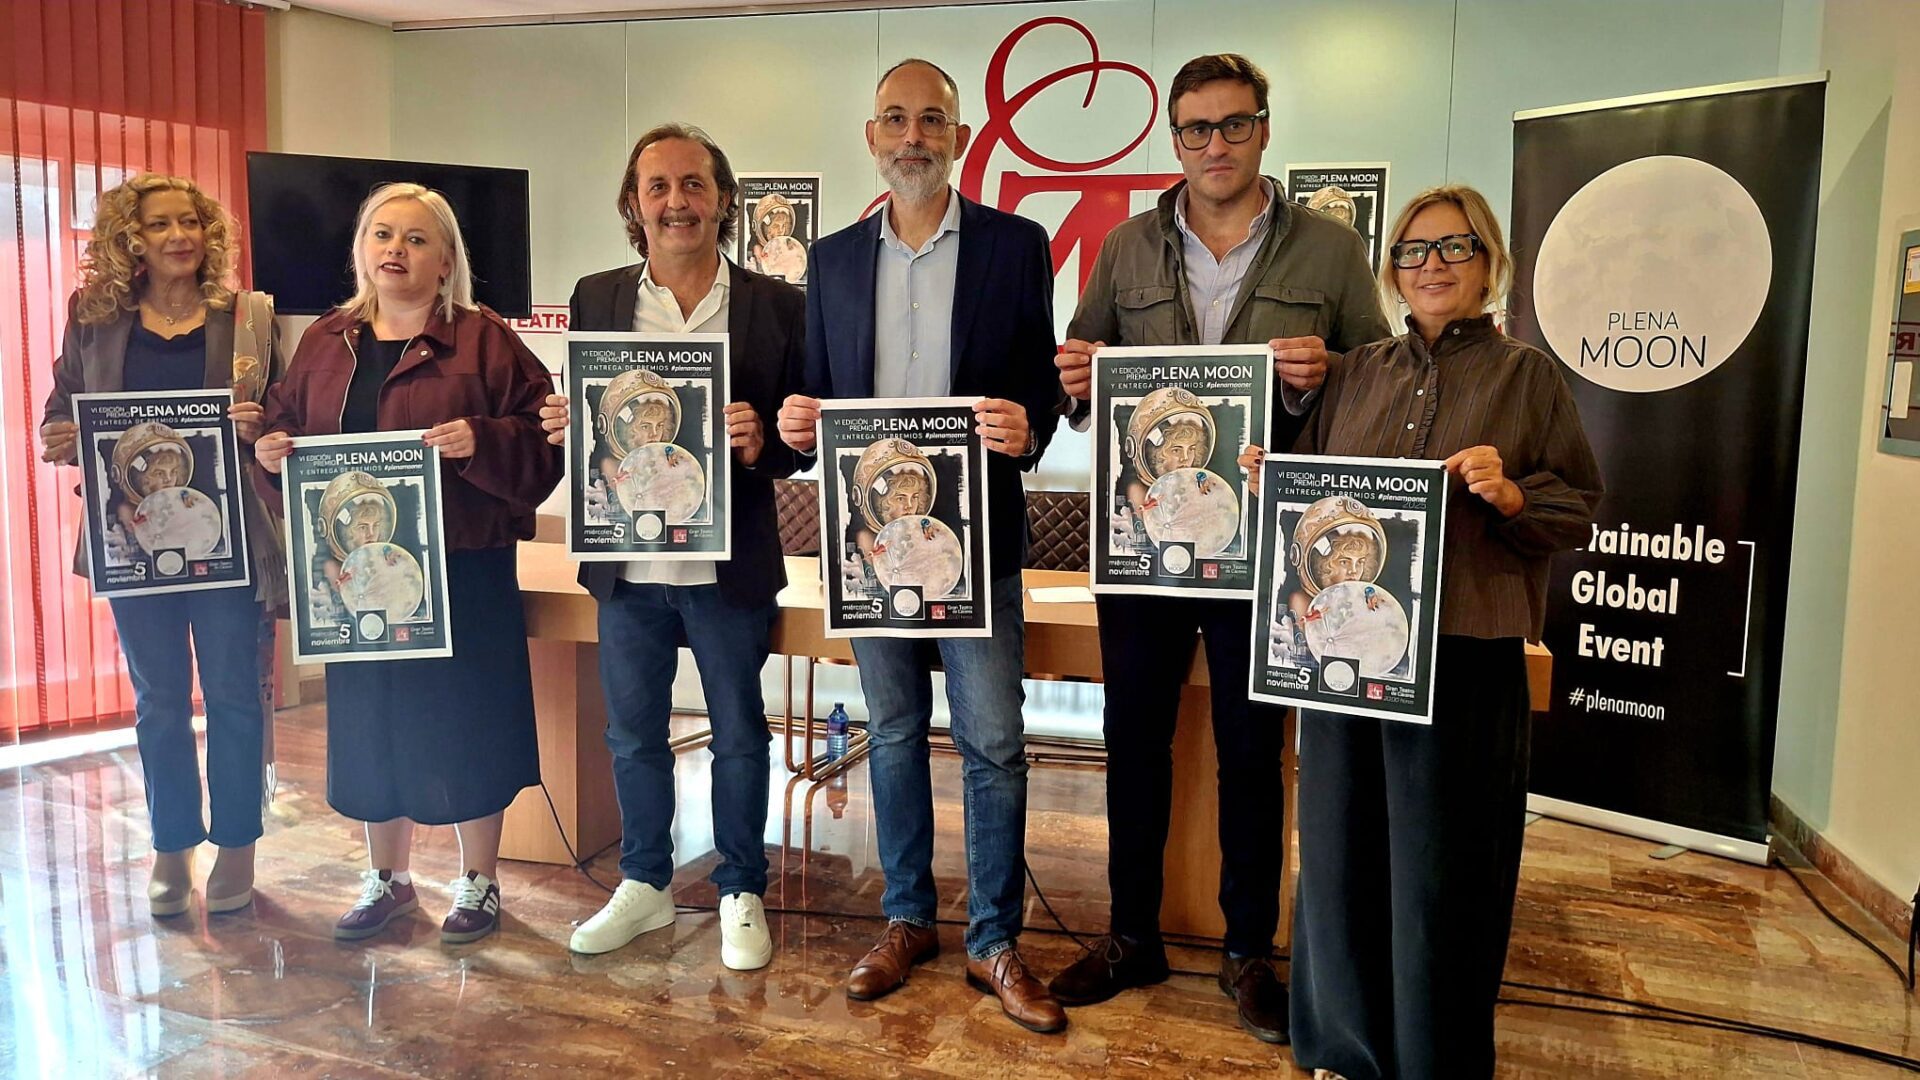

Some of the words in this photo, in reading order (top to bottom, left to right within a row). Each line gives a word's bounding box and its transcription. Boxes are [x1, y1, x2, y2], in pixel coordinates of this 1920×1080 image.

[1321, 175, 1348, 183] PLENA
[1350, 174, 1378, 182] MOON
[1608, 311, 1679, 331] PLENA
[620, 351, 665, 363] PLENA
[669, 351, 712, 363] MOON
[1580, 335, 1706, 368] MOON
[1152, 366, 1200, 380] PLENA
[1204, 365, 1253, 379] MOON
[130, 405, 174, 417] PLENA
[177, 403, 220, 415] MOON
[874, 418, 919, 431] PLENA
[922, 417, 967, 430] MOON
[335, 452, 378, 465] PLENA
[380, 450, 423, 463] MOON
[1286, 471, 1315, 479] EDICIÓN
[1293, 479, 1321, 487] PREMIO
[1321, 474, 1371, 490] PLENA
[1376, 477, 1429, 493] MOON
[1285, 488, 1321, 496] ENTREGA
[613, 523, 625, 537] 5
[134, 562, 146, 575] 5
[1139, 554, 1151, 570] 5
[1109, 568, 1150, 576] noviembre
[1571, 570, 1679, 615] Global
[871, 598, 883, 612] 5
[843, 612, 882, 620] noviembre
[340, 624, 350, 638] 5
[1578, 623, 1665, 667] Event
[1267, 670, 1297, 680] miércoles
[1298, 667, 1311, 684] 5
[1267, 679, 1309, 691] noviembre
[1568, 687, 1665, 720] #plenamoon
